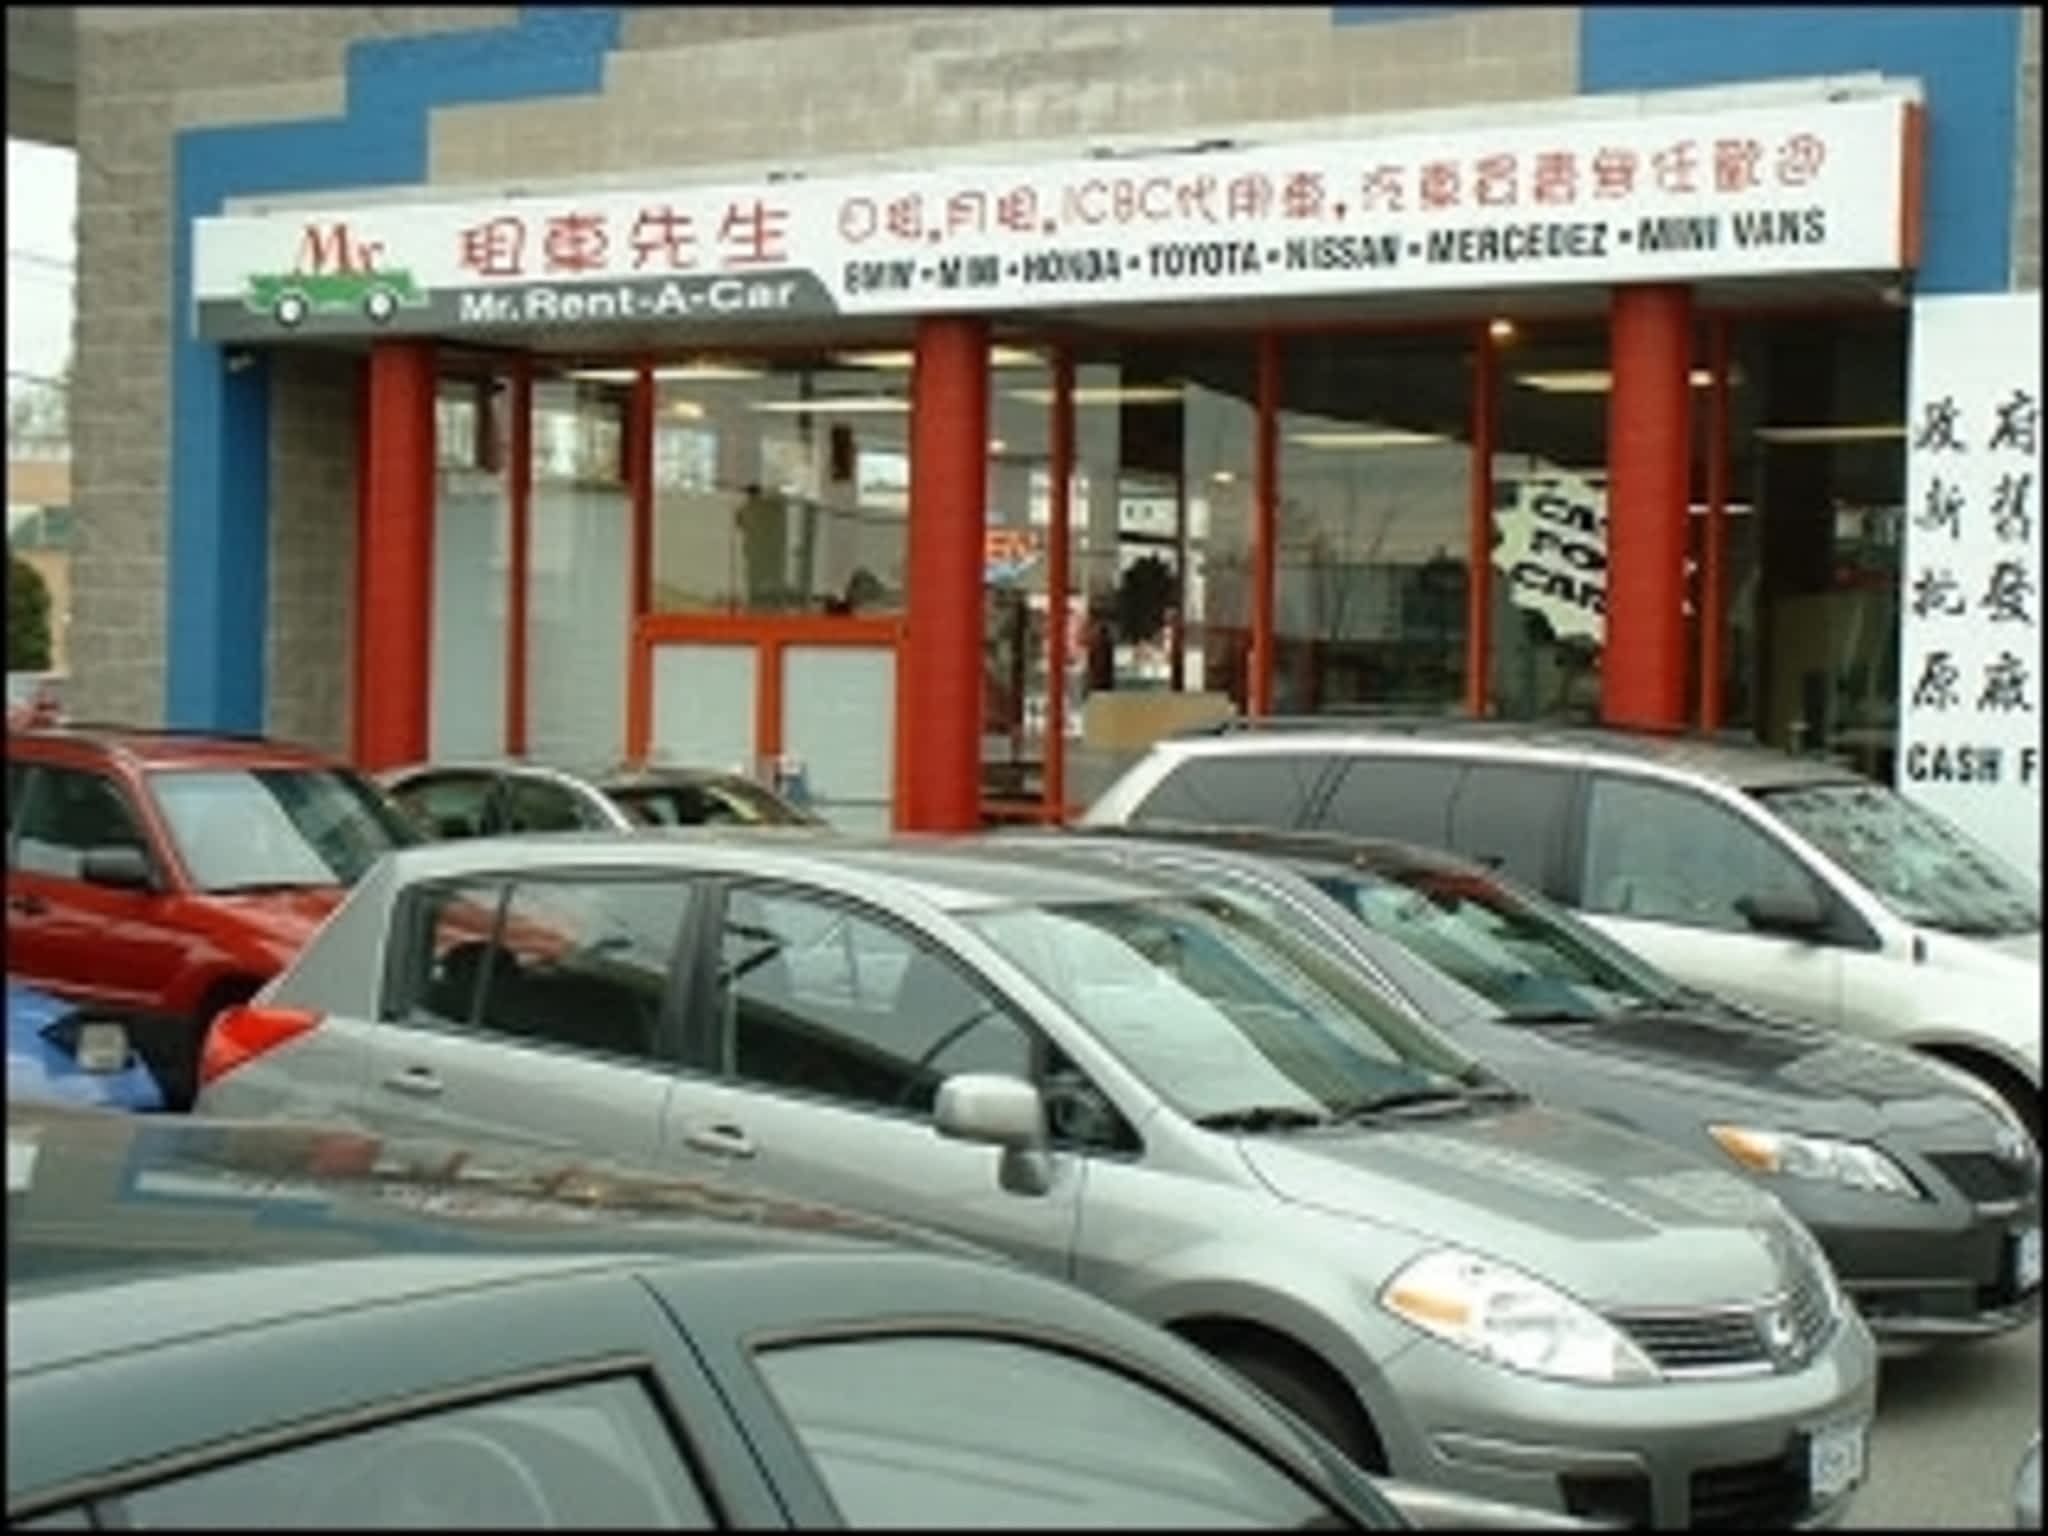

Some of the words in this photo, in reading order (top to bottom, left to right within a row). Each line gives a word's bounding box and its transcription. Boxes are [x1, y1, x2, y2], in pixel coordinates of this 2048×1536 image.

[1023, 246, 1122, 284] HONDA
[1147, 240, 1262, 279] TOYOTA
[1284, 233, 1401, 272] NISSAN
[1637, 213, 1719, 252] MINI
[1732, 206, 1826, 247] VANS
[1509, 562, 1608, 616] CAR
[1906, 743, 2002, 785] CASH
